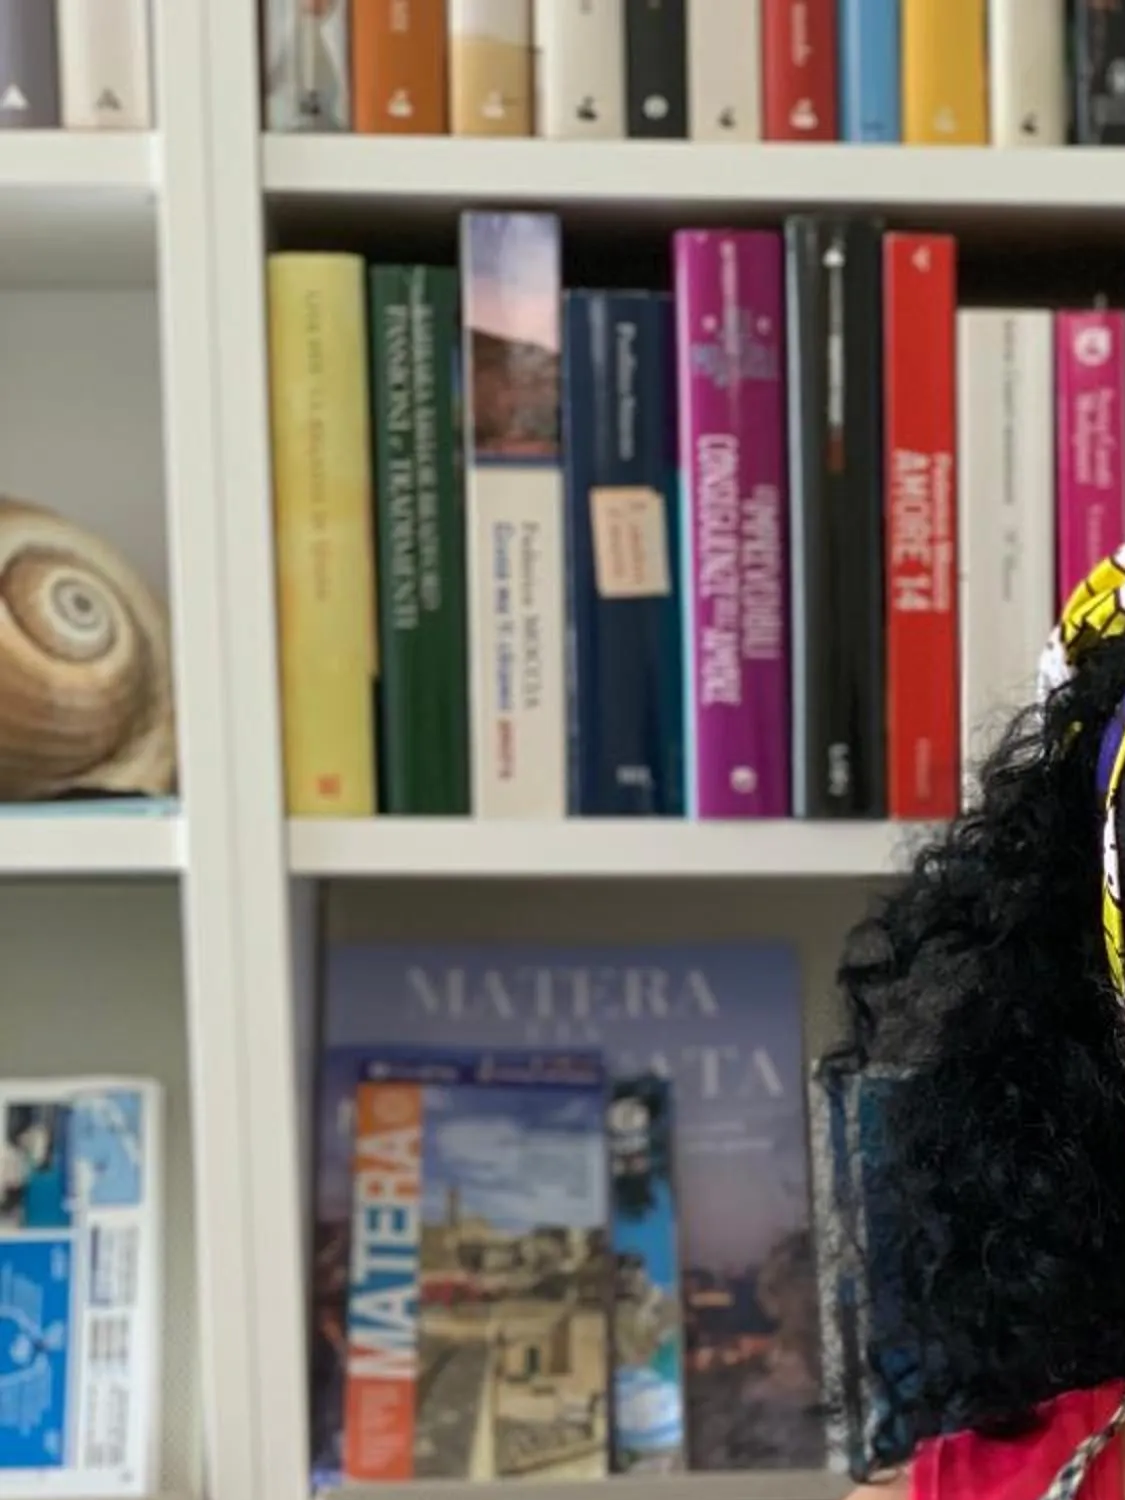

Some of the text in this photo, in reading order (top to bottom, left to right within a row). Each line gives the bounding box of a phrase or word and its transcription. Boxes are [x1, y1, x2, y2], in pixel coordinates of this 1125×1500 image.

[892, 448, 931, 613] AMORE 14
[404, 962, 722, 1022] MATERA
[349, 1122, 421, 1378] MATERA
